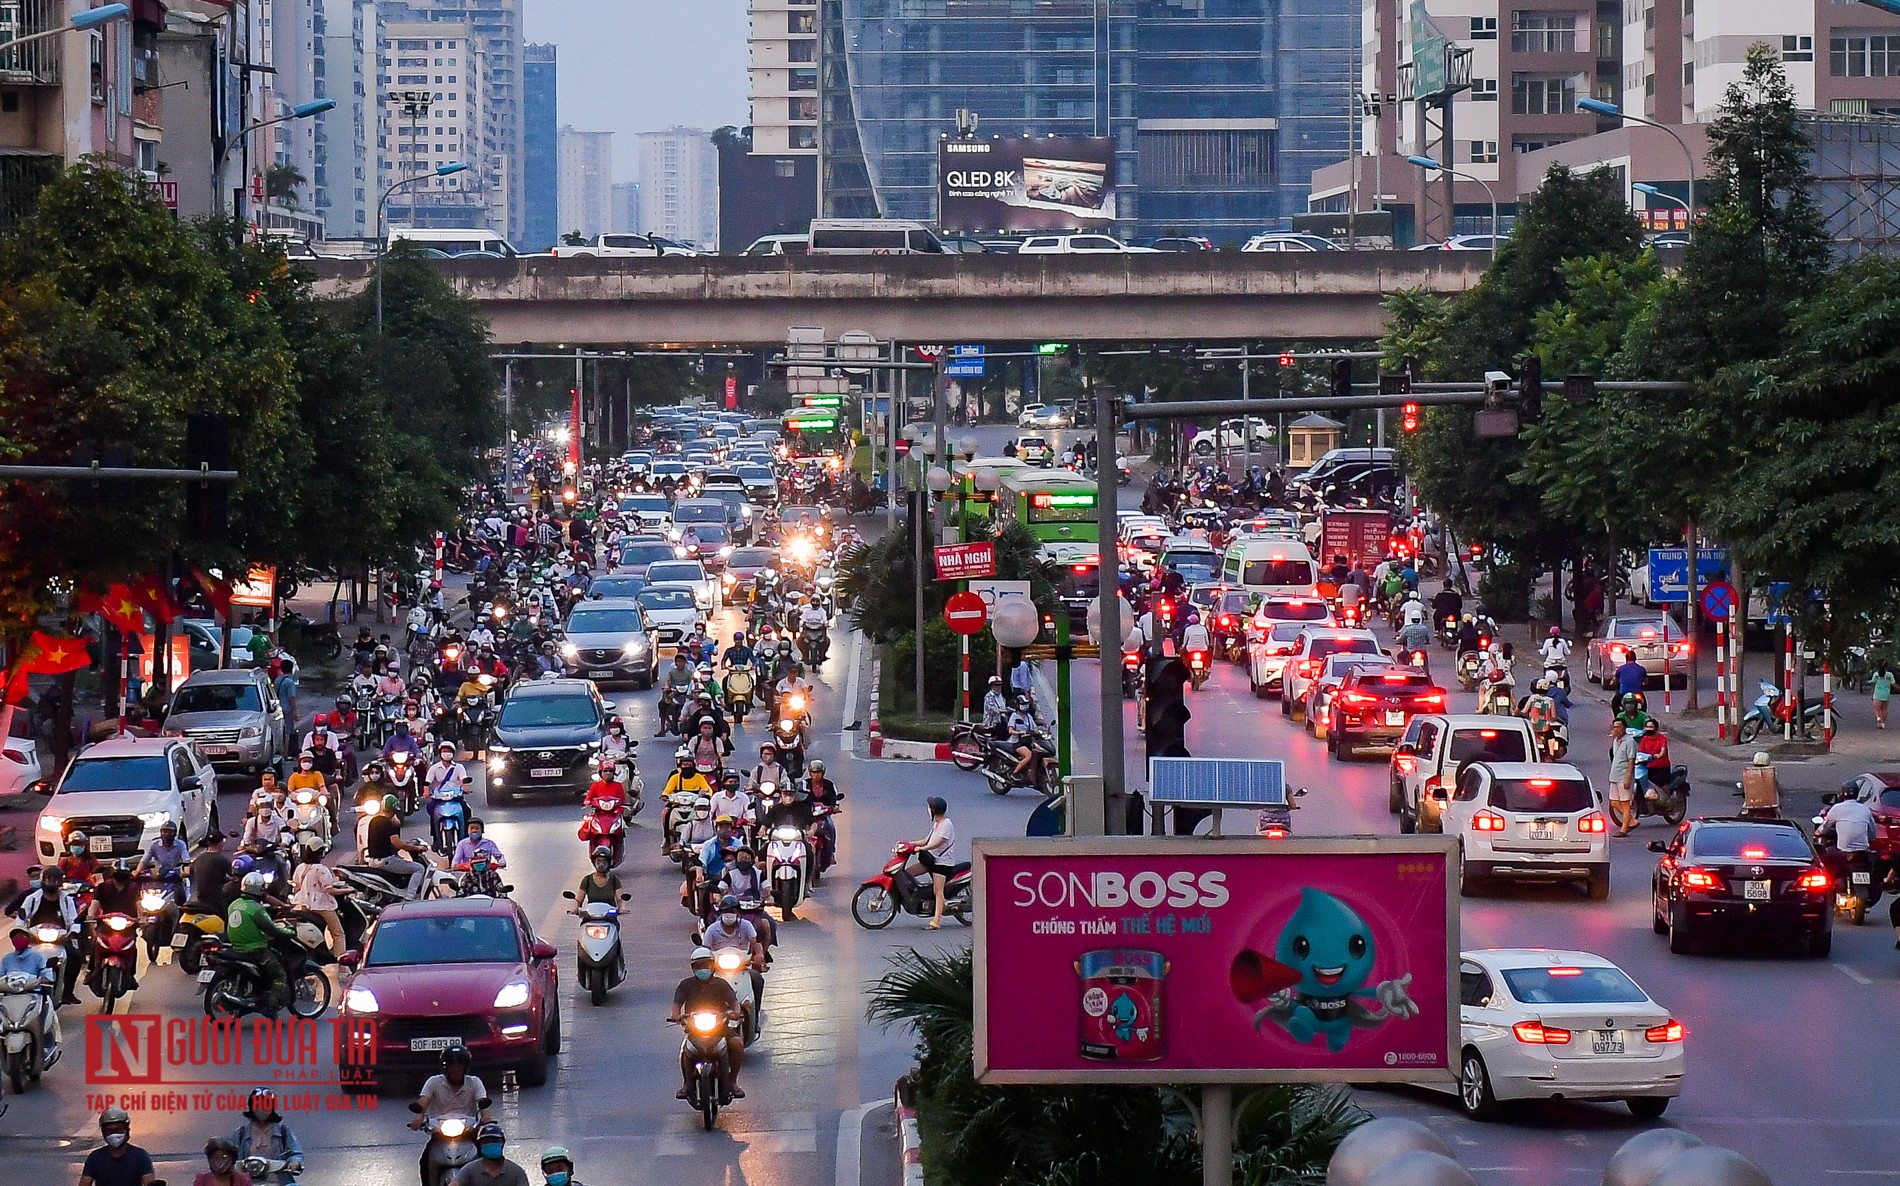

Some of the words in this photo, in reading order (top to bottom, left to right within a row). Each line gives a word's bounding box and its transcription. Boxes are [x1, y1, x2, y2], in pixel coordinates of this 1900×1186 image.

[947, 144, 990, 153] SAMSUNG
[947, 170, 991, 188] QLED
[994, 170, 1016, 188] 8K
[939, 551, 962, 567] NHÀ
[964, 548, 991, 565] NGHỈ
[1658, 552, 1682, 560] TRUNG
[1750, 882, 1765, 890] 30X
[1032, 915, 1076, 934] CHỐNG
[1079, 915, 1117, 934] THẤM
[1121, 910, 1151, 934] THẾ
[1156, 912, 1176, 936] HỆ
[1181, 910, 1213, 934] MỚI
[1600, 1031, 1614, 1041] 51F
